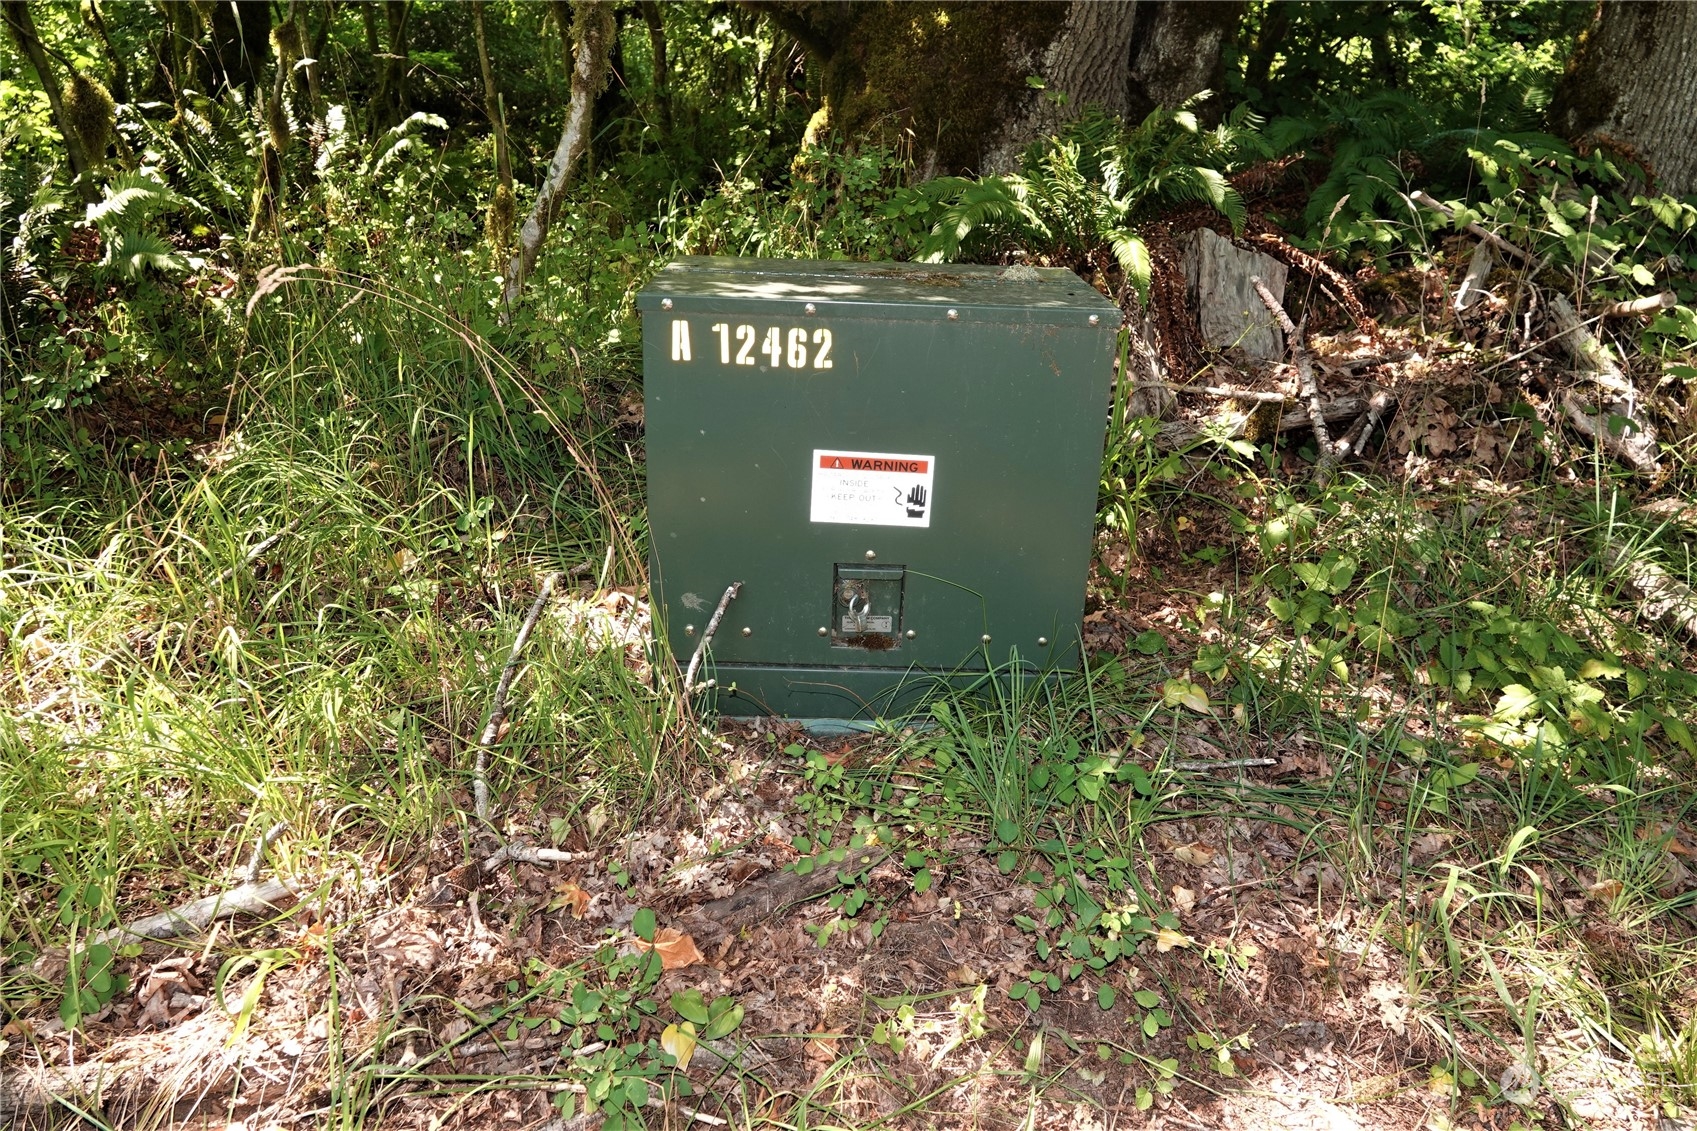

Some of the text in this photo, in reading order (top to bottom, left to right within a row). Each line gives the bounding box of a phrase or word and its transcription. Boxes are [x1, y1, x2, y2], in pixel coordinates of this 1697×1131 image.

[671, 320, 832, 369] A 12462
[851, 459, 918, 473] WARNING
[839, 479, 869, 488] INSIDE
[831, 493, 855, 501] KEEP
